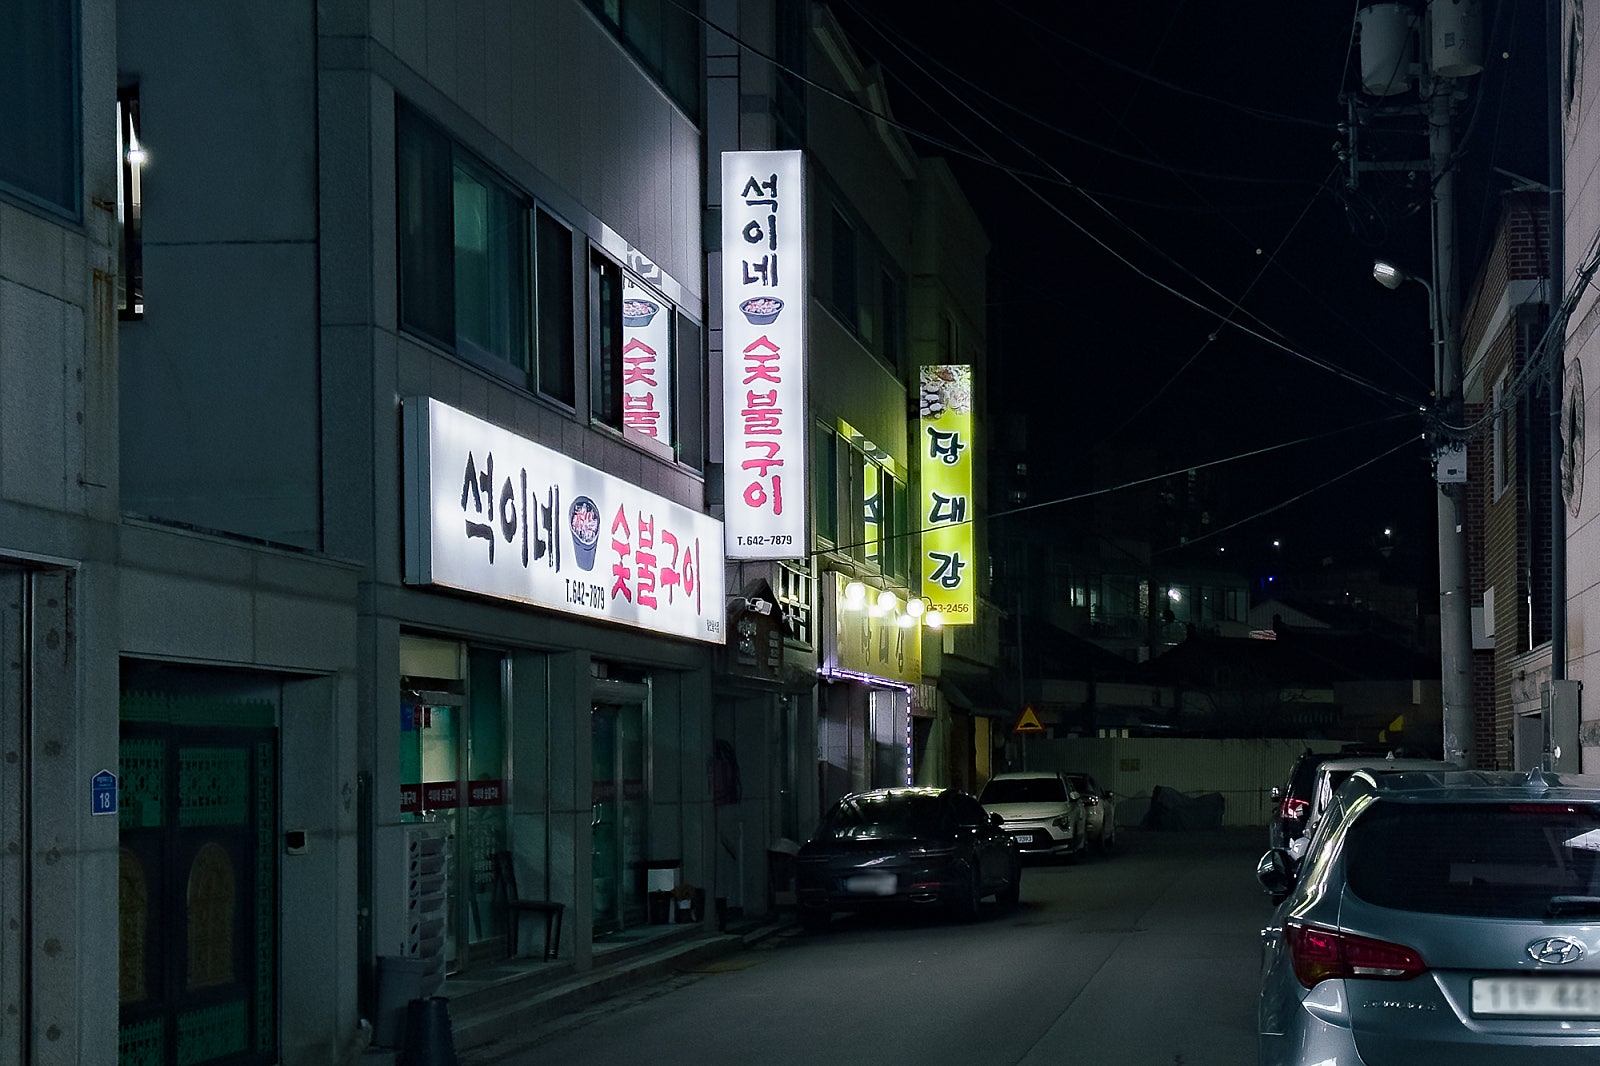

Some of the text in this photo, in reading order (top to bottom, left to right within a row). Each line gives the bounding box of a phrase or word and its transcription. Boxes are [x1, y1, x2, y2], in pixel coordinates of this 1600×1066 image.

[741, 173, 778, 287] 석이네
[741, 335, 784, 516] 숯불구이
[461, 450, 701, 616] 석이네 숯불구이
[737, 535, 792, 546] T.642-7879
[565, 578, 605, 610] T.642-7879
[99, 792, 110, 809] 18
